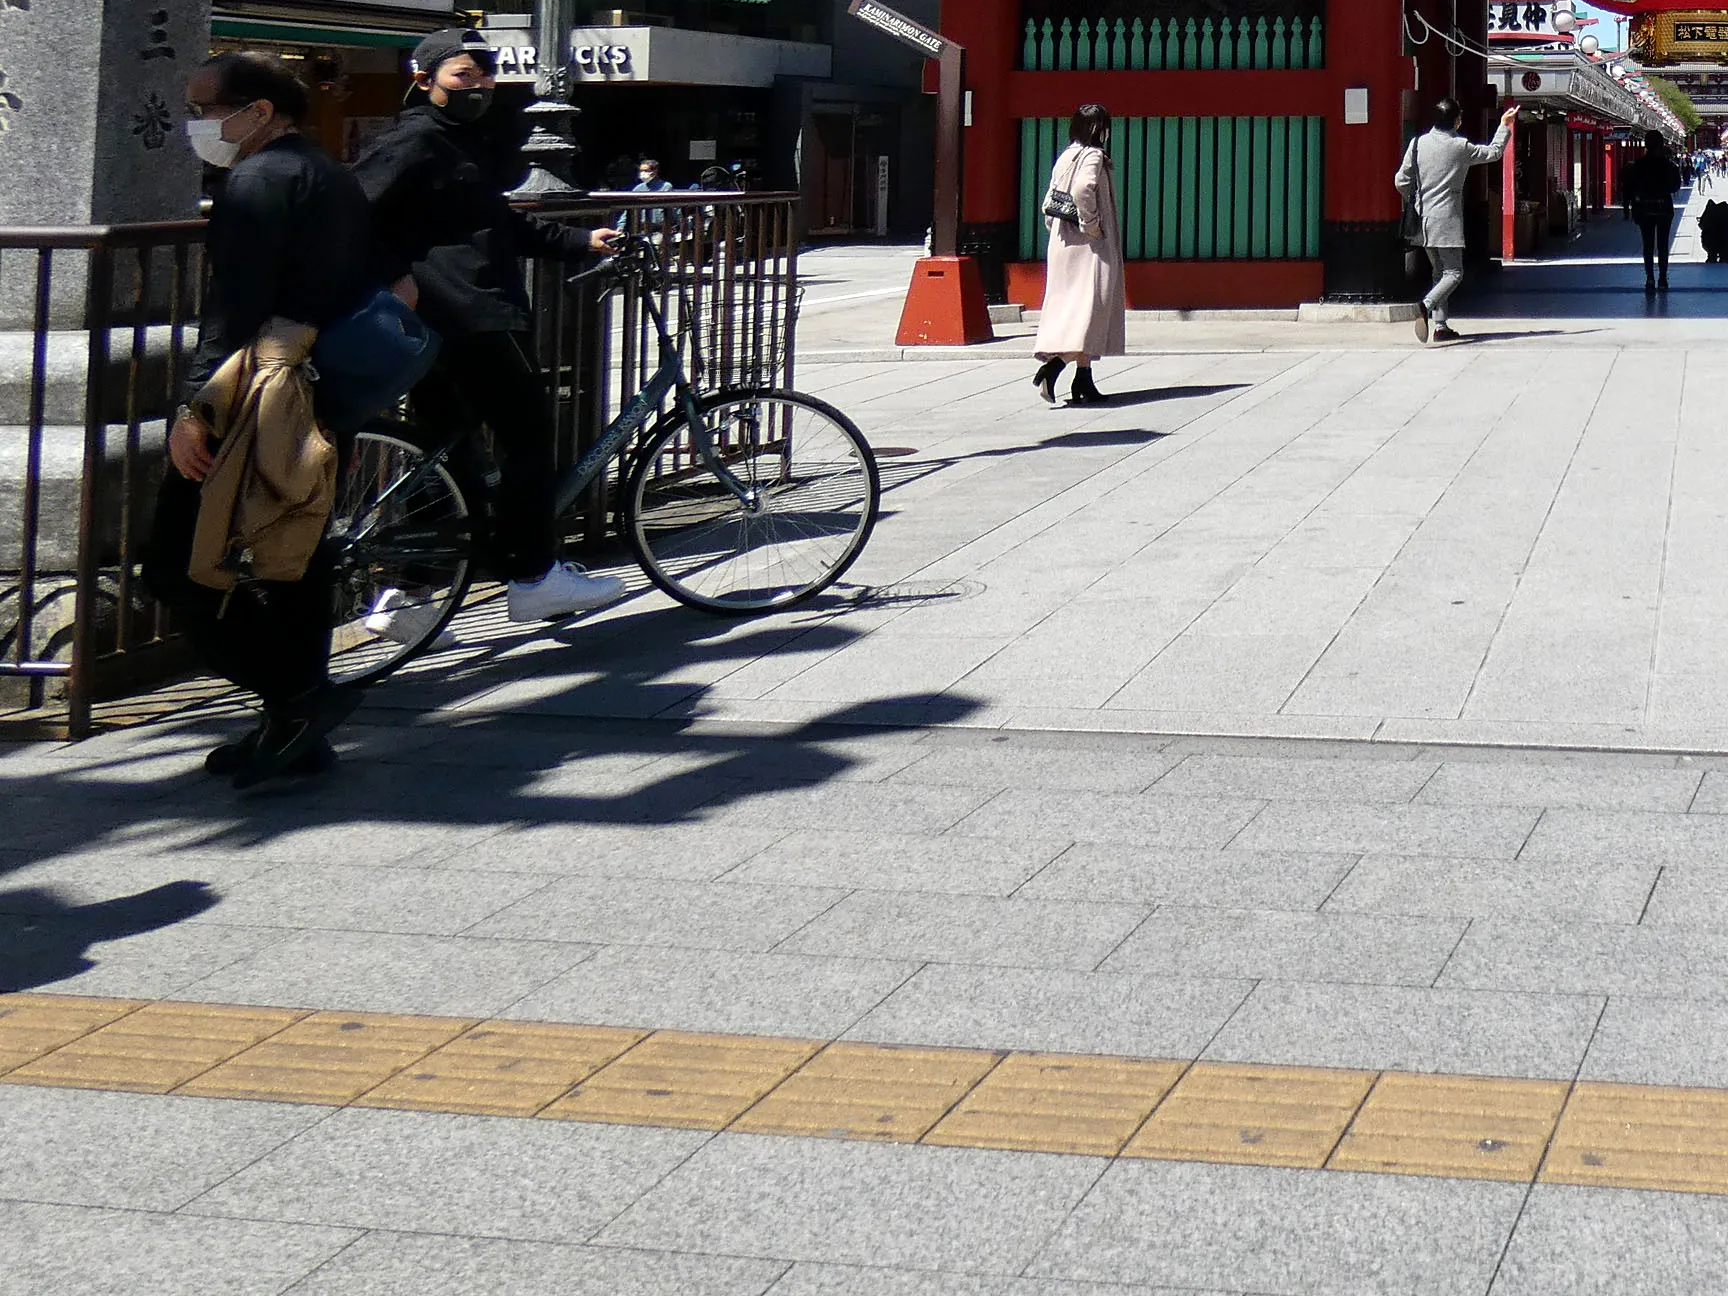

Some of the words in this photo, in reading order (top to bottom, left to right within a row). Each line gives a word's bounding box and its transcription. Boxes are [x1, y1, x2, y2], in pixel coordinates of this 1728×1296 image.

[863, 3, 921, 37] KAMINARIMON
[919, 32, 943, 49] GATE
[489, 45, 628, 65] ARCKS
